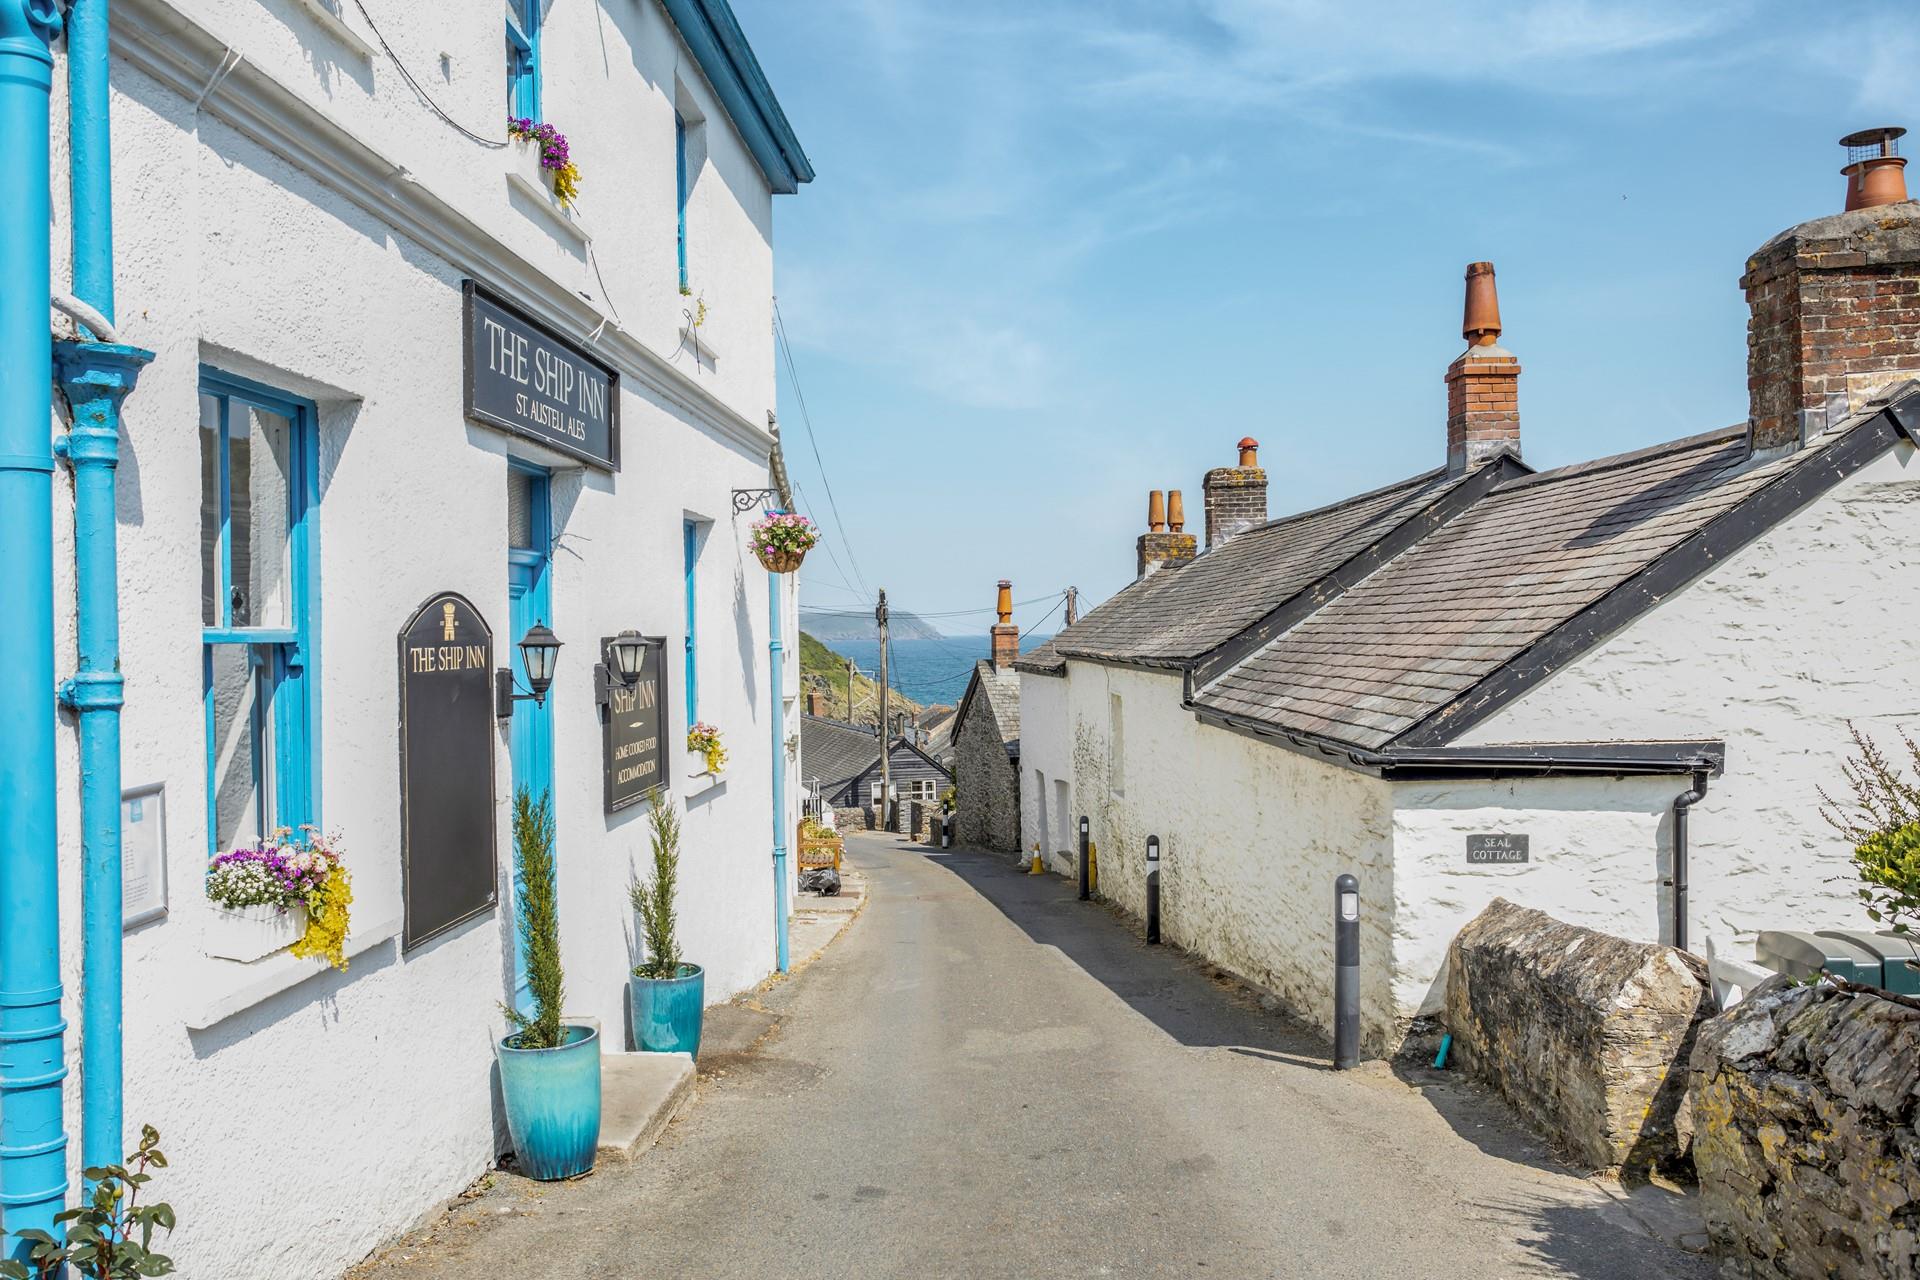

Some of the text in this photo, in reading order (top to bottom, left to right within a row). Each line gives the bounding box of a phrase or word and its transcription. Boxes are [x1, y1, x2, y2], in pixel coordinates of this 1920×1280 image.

[484, 317, 605, 424] THE SHIP INN
[516, 393, 586, 441] ST. AUSTELL ALES
[410, 645, 486, 673] THE SHIP INN
[639, 680, 656, 710] INN
[615, 736, 657, 761] HOME COOKED FOOD
[1472, 850, 1523, 860] COTTAGE
[1484, 838, 1512, 848] SEAL
